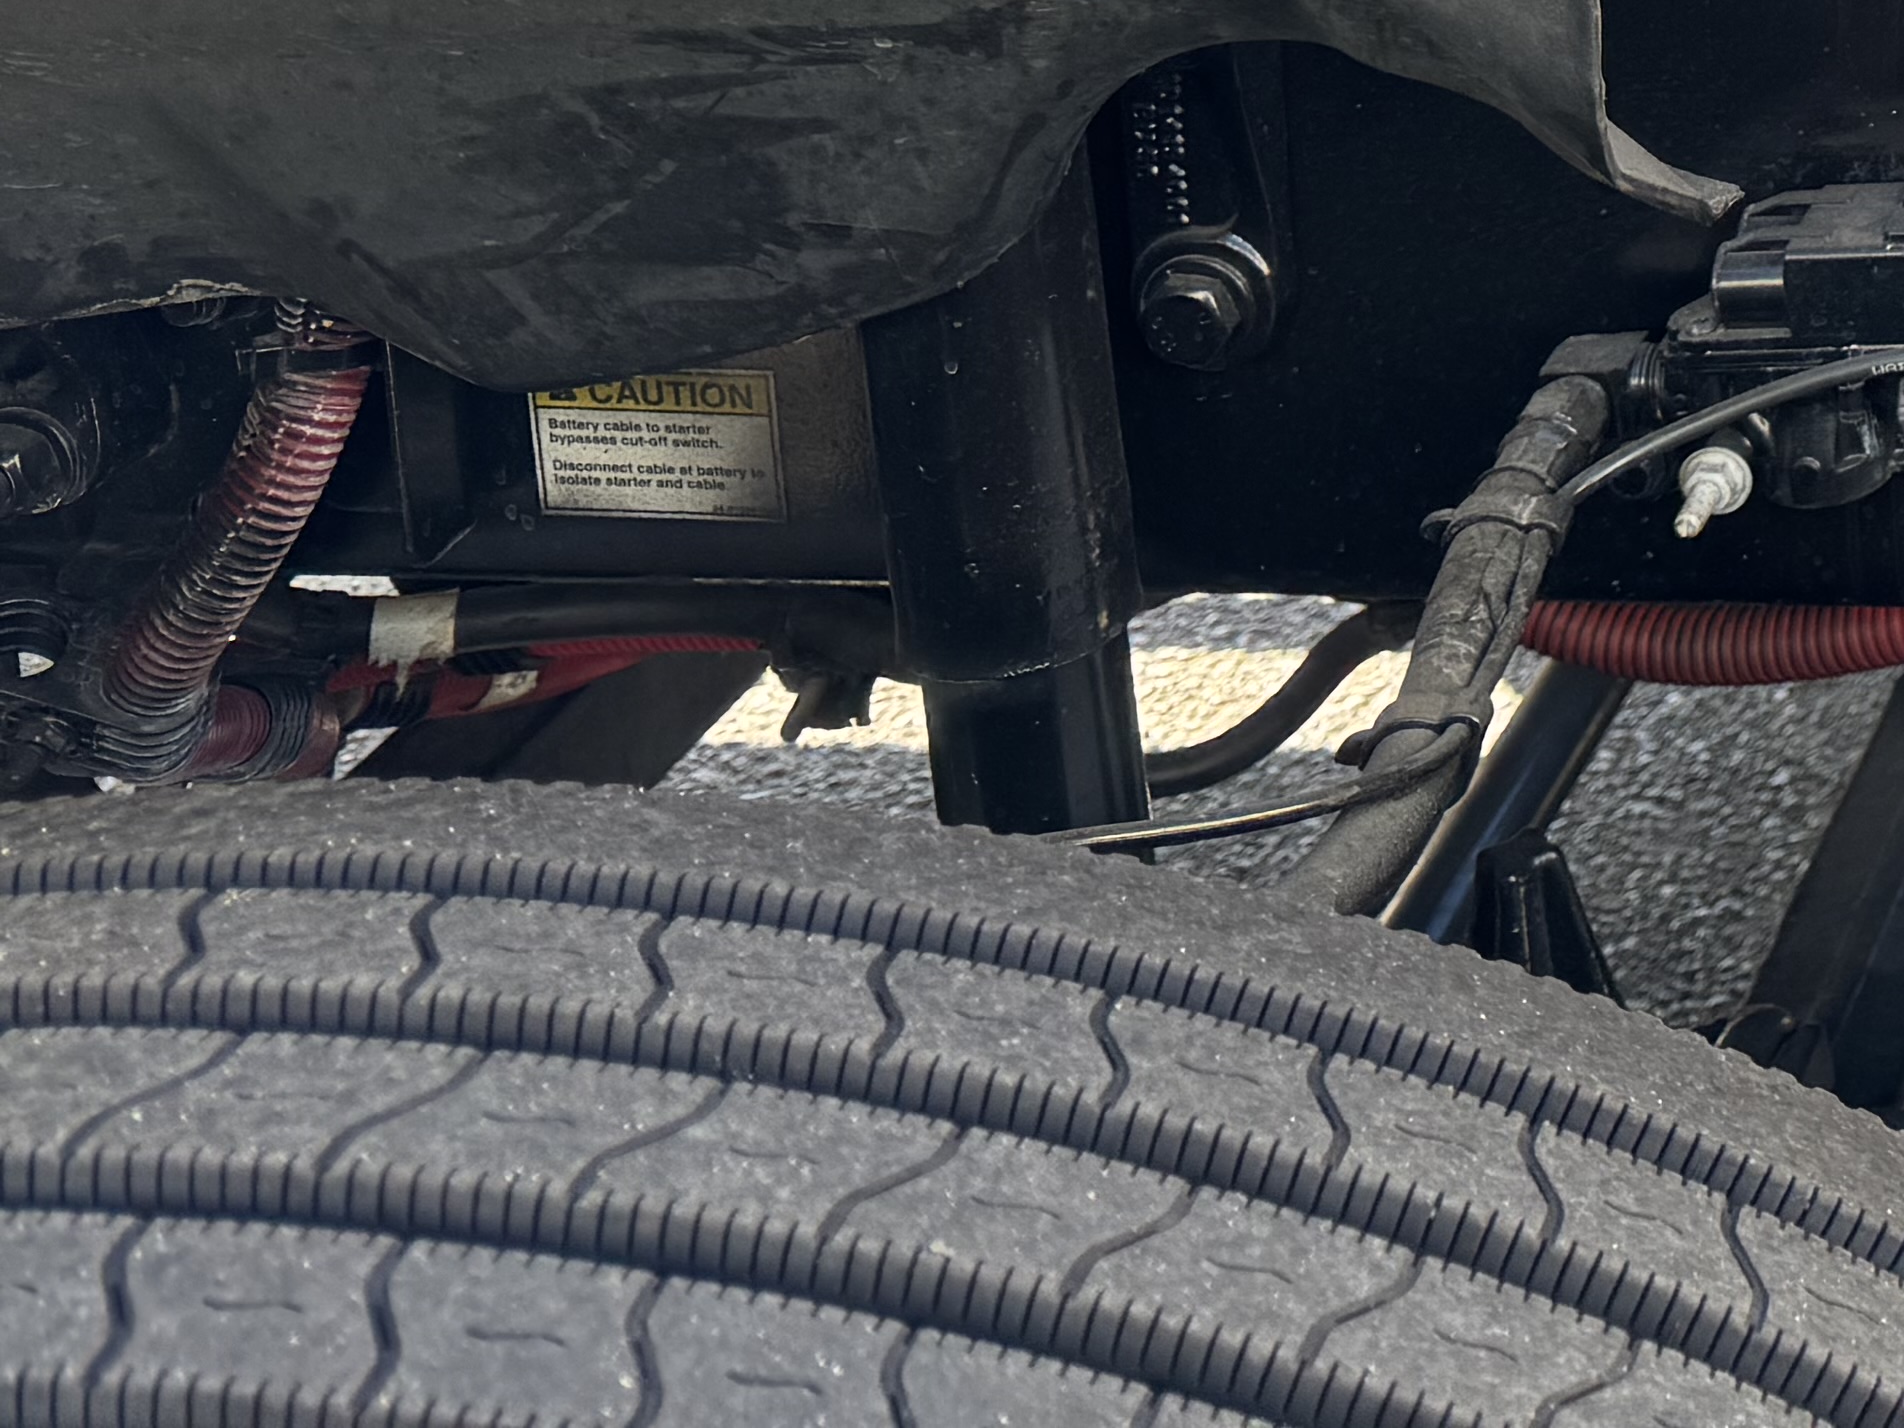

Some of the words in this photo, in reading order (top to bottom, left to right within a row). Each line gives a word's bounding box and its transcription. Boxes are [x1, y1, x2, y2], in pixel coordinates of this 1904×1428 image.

[588, 378, 754, 410] CAUTION
[548, 418, 599, 433] Battery
[603, 420, 642, 433] cable
[646, 421, 660, 433] to
[664, 423, 712, 435] starter
[549, 432, 617, 446] bypasses
[620, 434, 668, 448] cut-off
[672, 436, 724, 450] switch.
[552, 459, 633, 474] Disconnect
[637, 462, 675, 476] cable
[679, 464, 694, 477] at
[696, 465, 747, 482] battery
[553, 473, 601, 486] Isolate
[605, 475, 653, 488] starter
[655, 477, 684, 490] and
